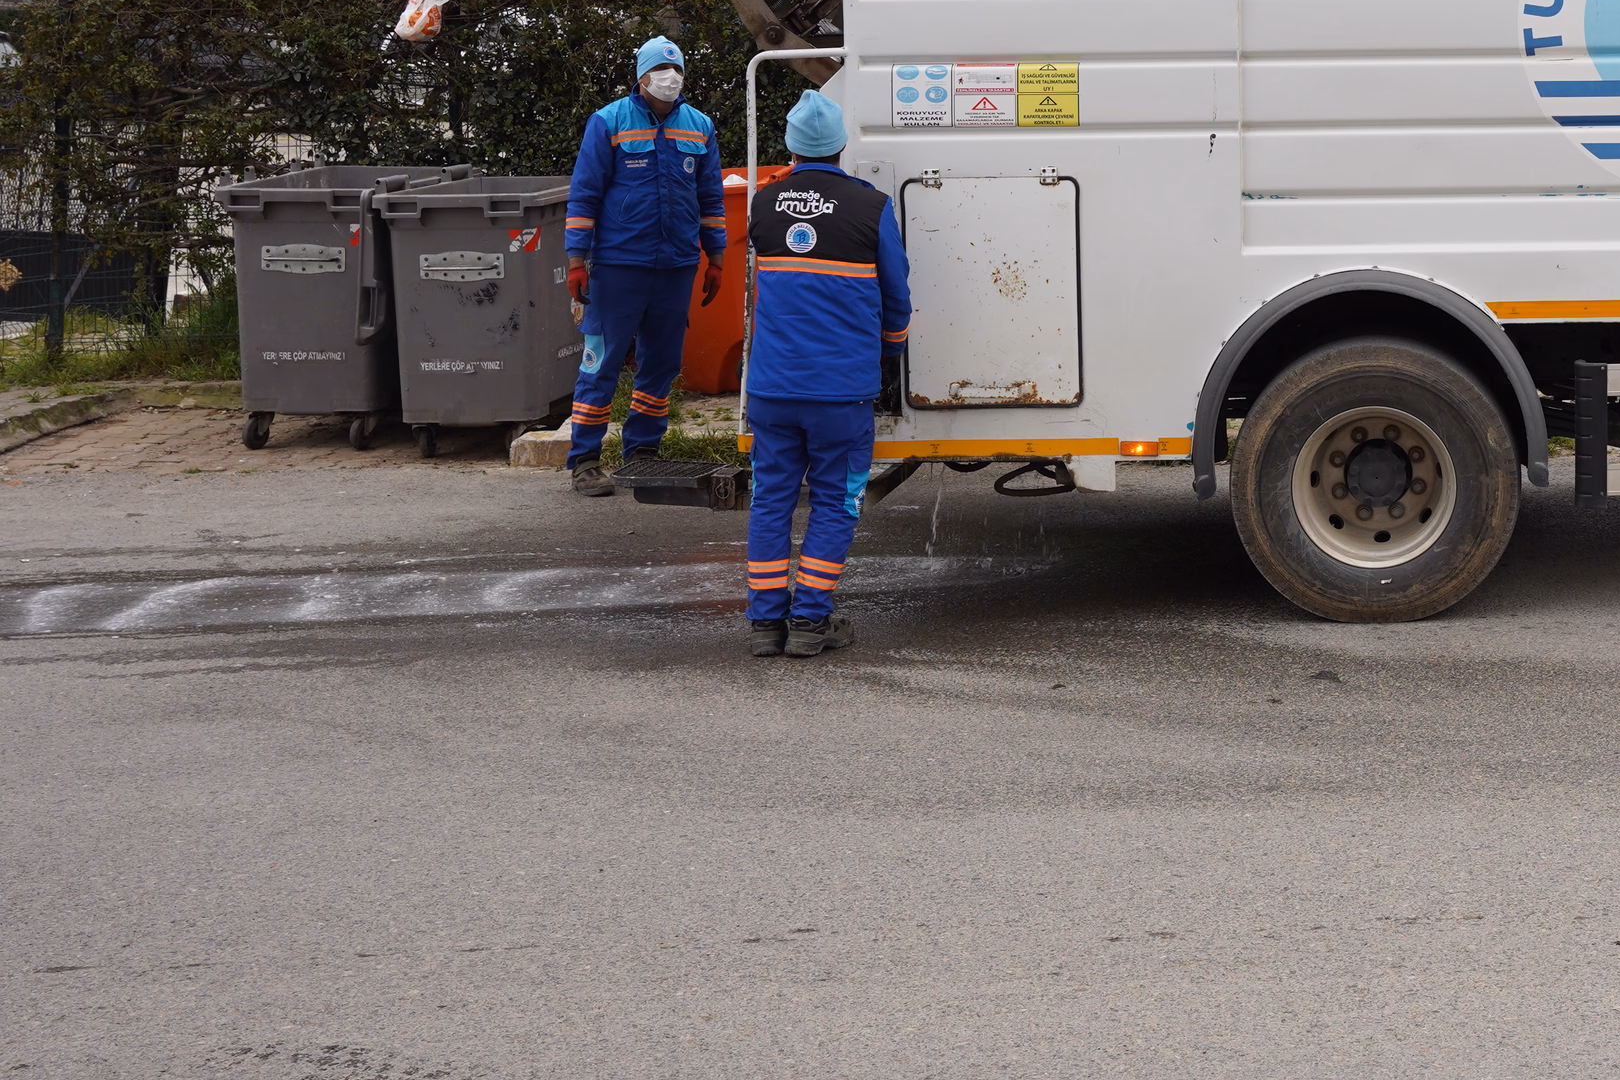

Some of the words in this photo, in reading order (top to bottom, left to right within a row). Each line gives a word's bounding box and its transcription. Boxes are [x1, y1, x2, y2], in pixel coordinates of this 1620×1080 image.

[777, 189, 820, 201] geleceğe
[775, 198, 836, 215] umutla
[262, 352, 292, 360] YERERE
[466, 362, 500, 370] ATYINIZ
